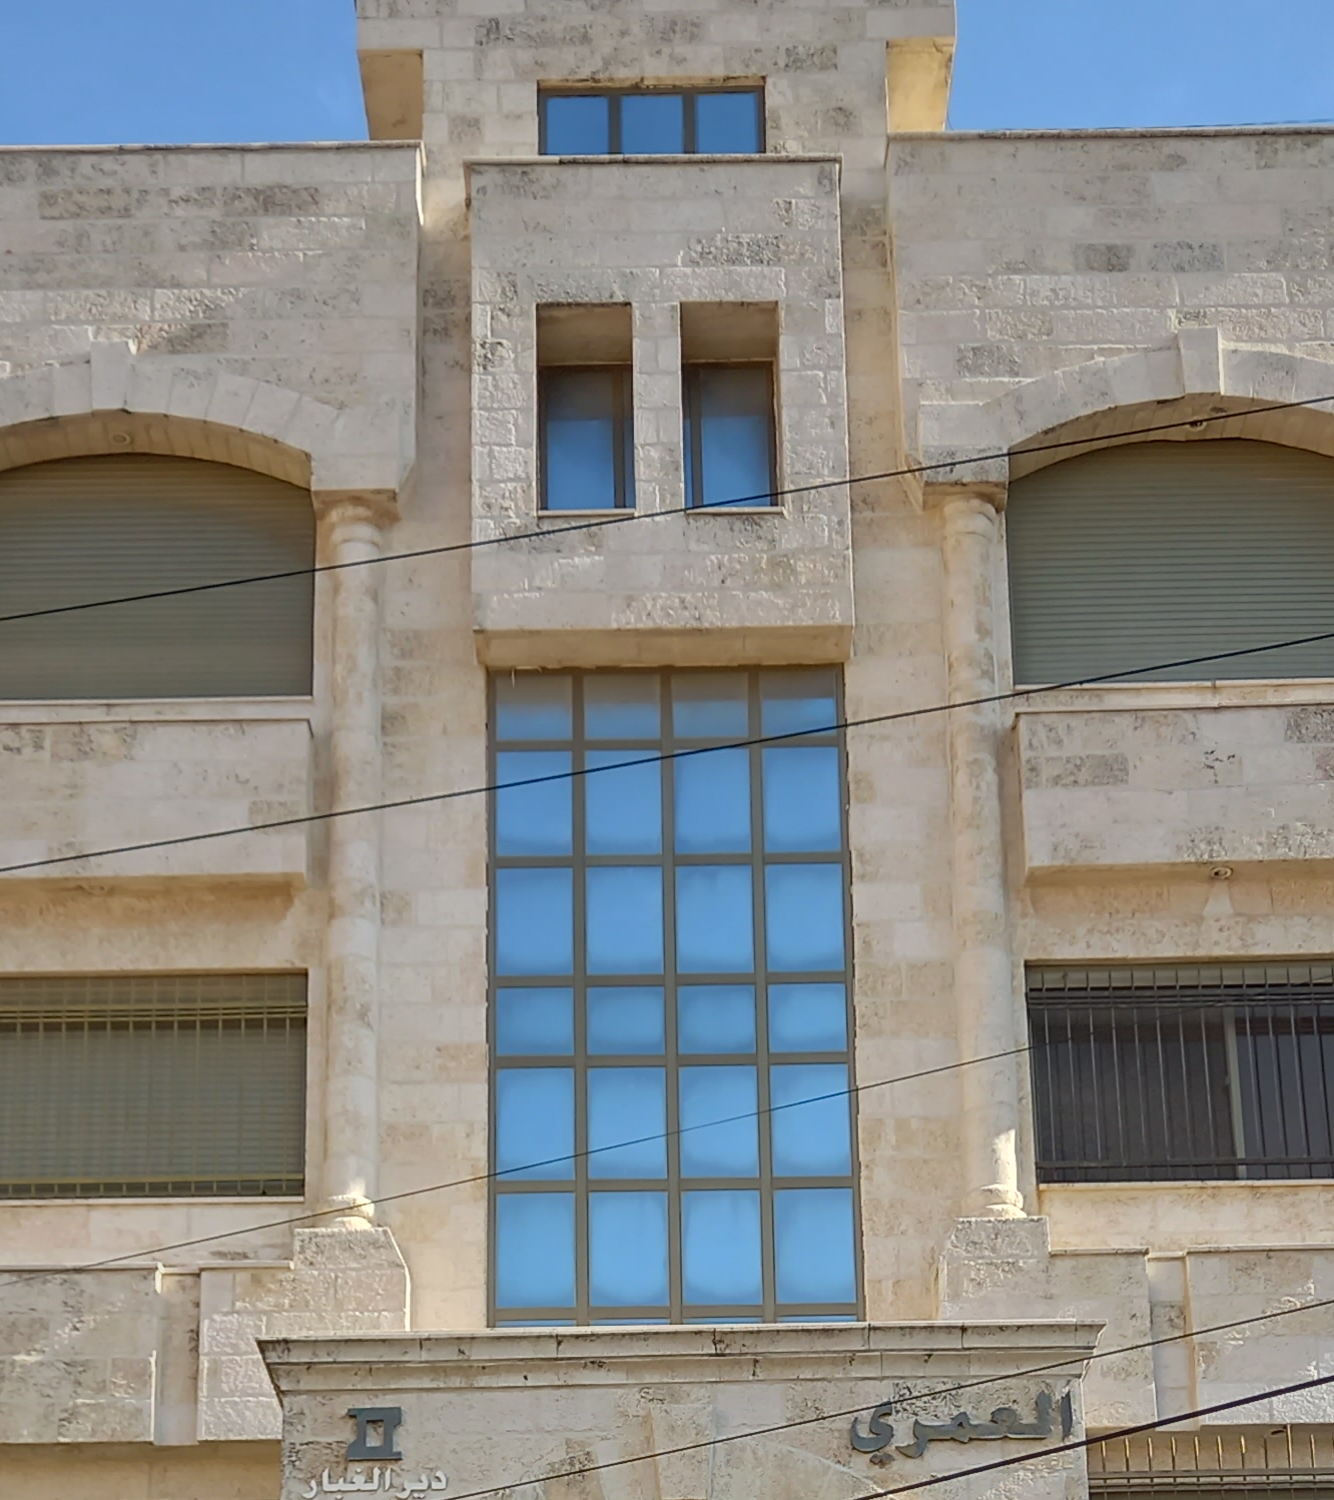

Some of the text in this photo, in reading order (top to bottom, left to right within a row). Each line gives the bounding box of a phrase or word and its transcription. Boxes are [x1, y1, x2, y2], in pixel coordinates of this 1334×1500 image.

[850, 1389, 1074, 1467] العمري
[301, 1466, 448, 1500] دير الغبار
